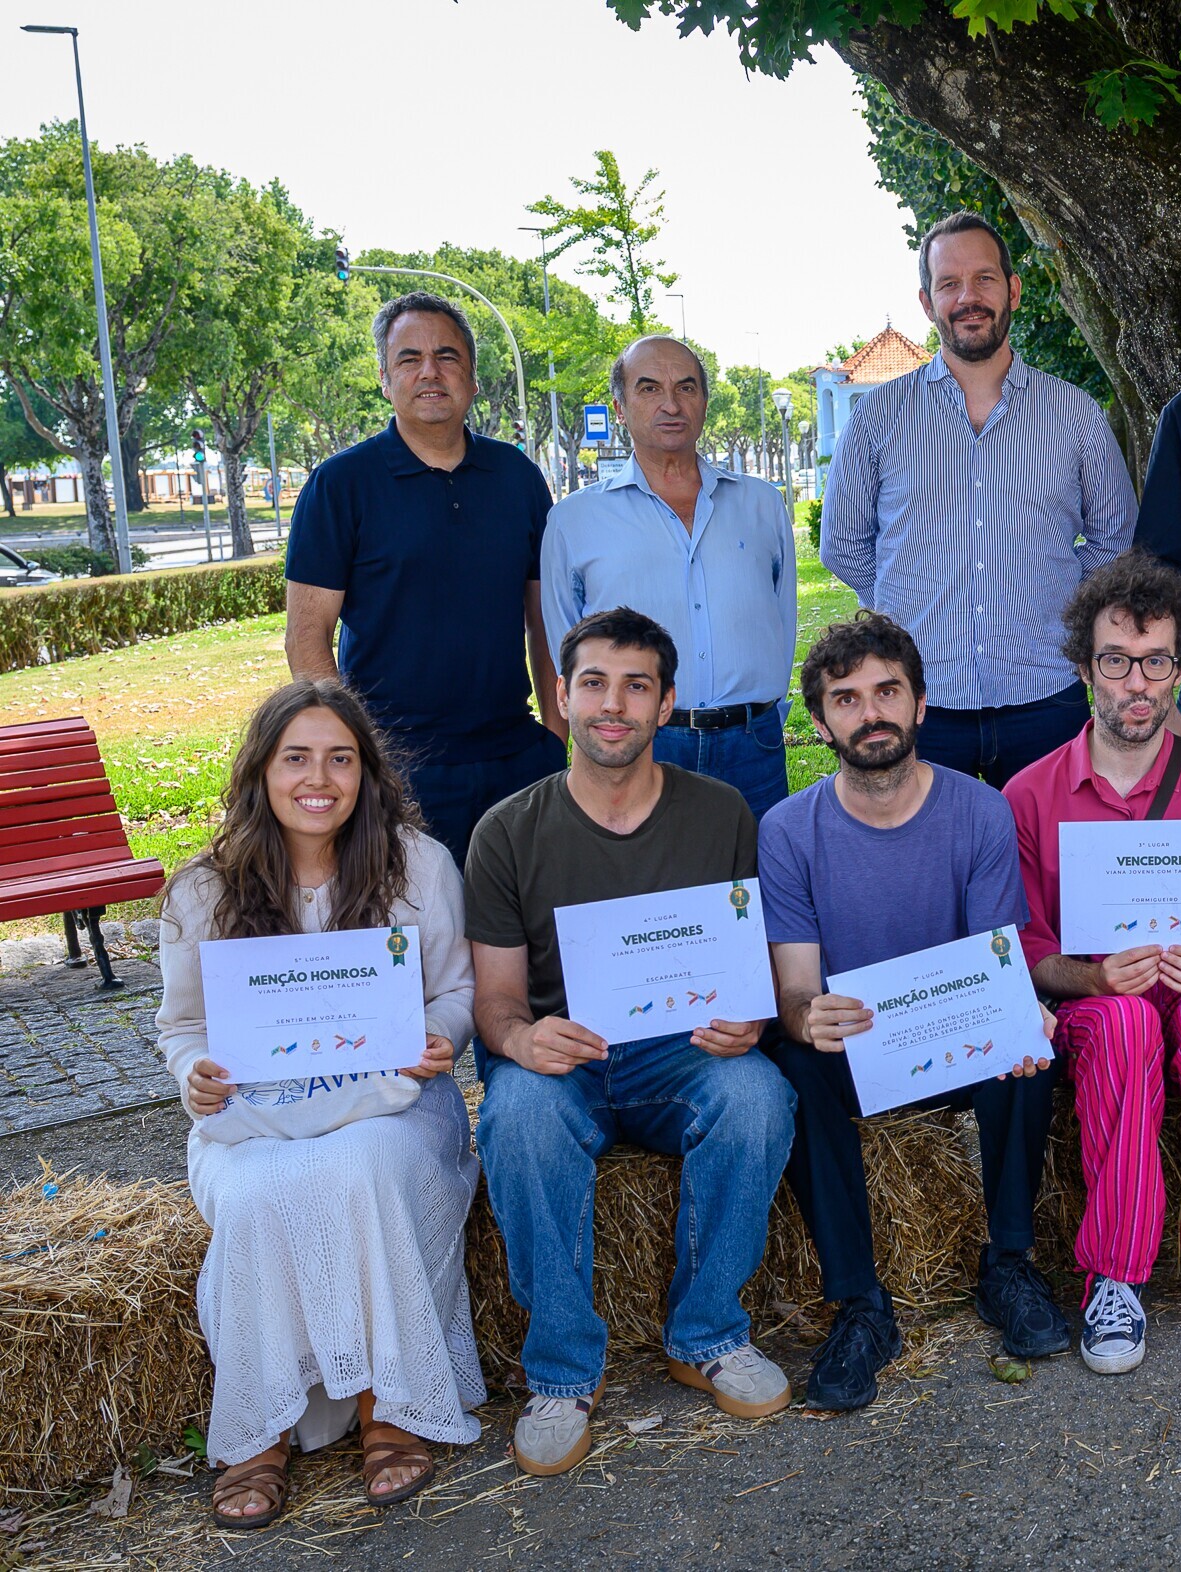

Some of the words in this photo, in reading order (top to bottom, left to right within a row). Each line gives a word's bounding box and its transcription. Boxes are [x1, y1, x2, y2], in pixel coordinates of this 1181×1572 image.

[621, 924, 703, 946] VENCEDORES
[612, 949, 634, 957] VIANA
[686, 937, 718, 945] TALENTO
[249, 970, 307, 987] MENÇÃO
[311, 967, 378, 981] HONROSA
[646, 972, 692, 983] ESCAPARATE
[922, 970, 944, 979] LUGAR
[877, 988, 928, 1013] MENÇÃO
[931, 972, 990, 996] HONROSA
[887, 1009, 909, 1019] VIANA
[911, 1003, 936, 1013] JOVENS
[956, 987, 986, 1000] TALENTO
[987, 1008, 1003, 1016] LIMA
[937, 1009, 980, 1023] ONTOLOGIAS
[910, 1035, 927, 1045] ALTO
[942, 1025, 962, 1035] SERRA
